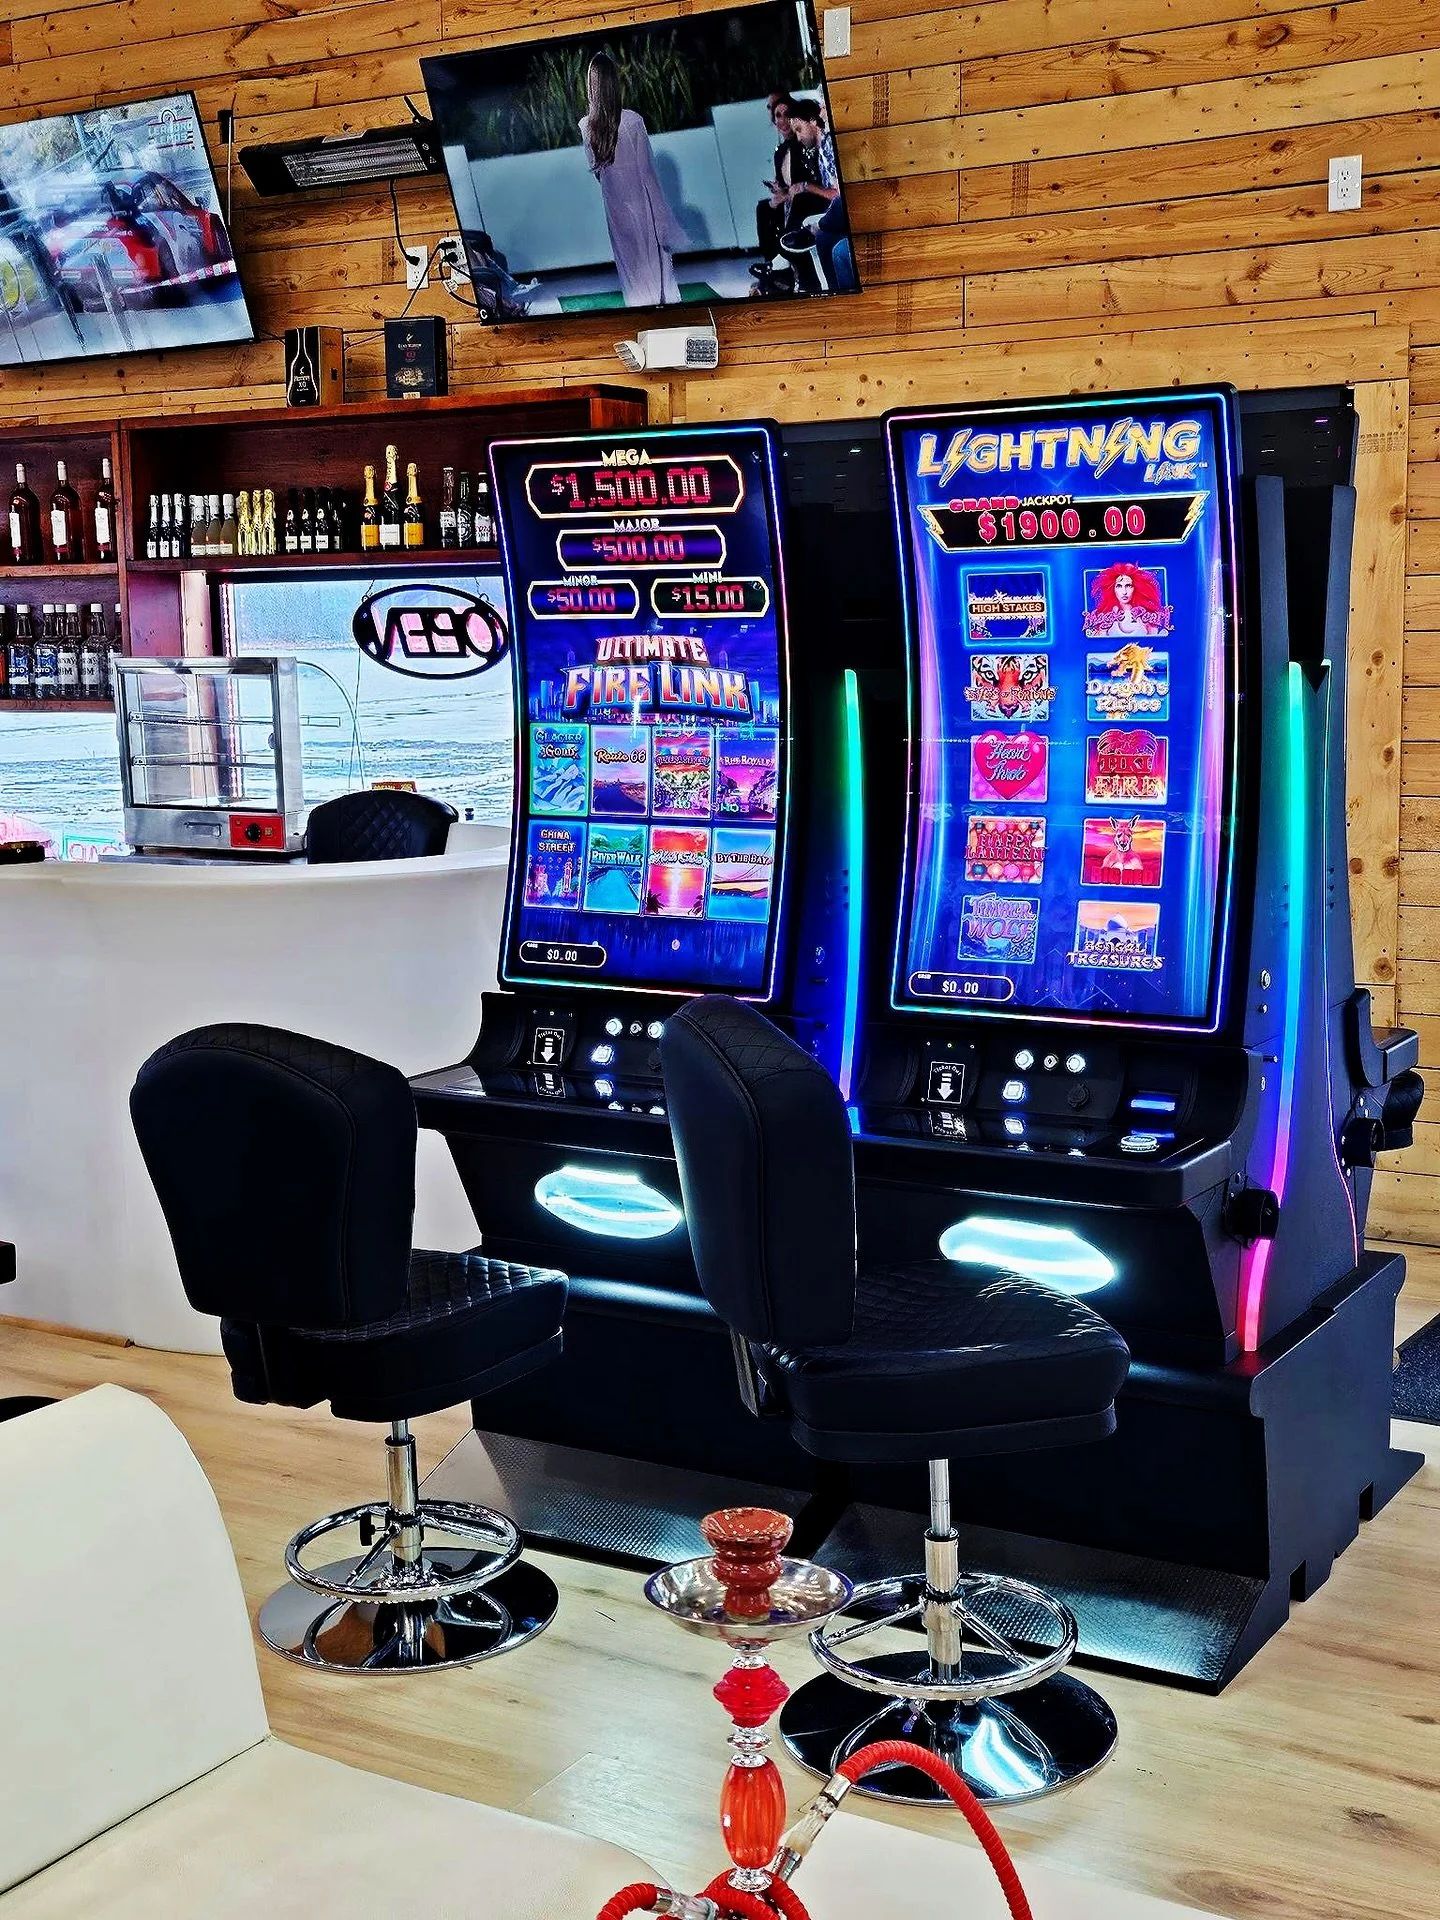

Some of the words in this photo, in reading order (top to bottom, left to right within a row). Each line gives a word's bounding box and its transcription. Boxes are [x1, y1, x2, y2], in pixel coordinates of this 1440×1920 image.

[601, 449, 652, 467] MEGA
[917, 417, 1202, 487] LIGHTNING
[949, 497, 1020, 513] GRAND
[1020, 494, 1074, 507] JACKPOT
[613, 518, 661, 532] MAJOR
[592, 535, 685, 562] $500.00
[562, 575, 599, 587] MINOR
[692, 571, 722, 583] MINI
[547, 587, 616, 611] $50.00
[671, 585, 745, 611] $15.00
[972, 603, 1000, 613] HIGH
[1002, 602, 1042, 612] STAKES
[596, 635, 709, 663] ULTIMATE
[560, 663, 651, 710] FIRE
[654, 661, 752, 712] LINK
[630, 749, 647, 763] 66
[986, 740, 1031, 760] Heart
[1094, 774, 1158, 798] FIRE
[540, 829, 570, 841] CHINA
[977, 833, 1037, 849] HAPPY
[538, 842, 576, 853] STREET
[964, 847, 1047, 862] LANTERN
[716, 853, 729, 863] BY
[729, 854, 748, 863] THE
[749, 854, 769, 865] BAY
[962, 917, 1037, 942] WOLF
[547, 949, 578, 962] $0.00
[1068, 951, 1164, 970] TREASURES
[942, 980, 979, 994] $0.00
